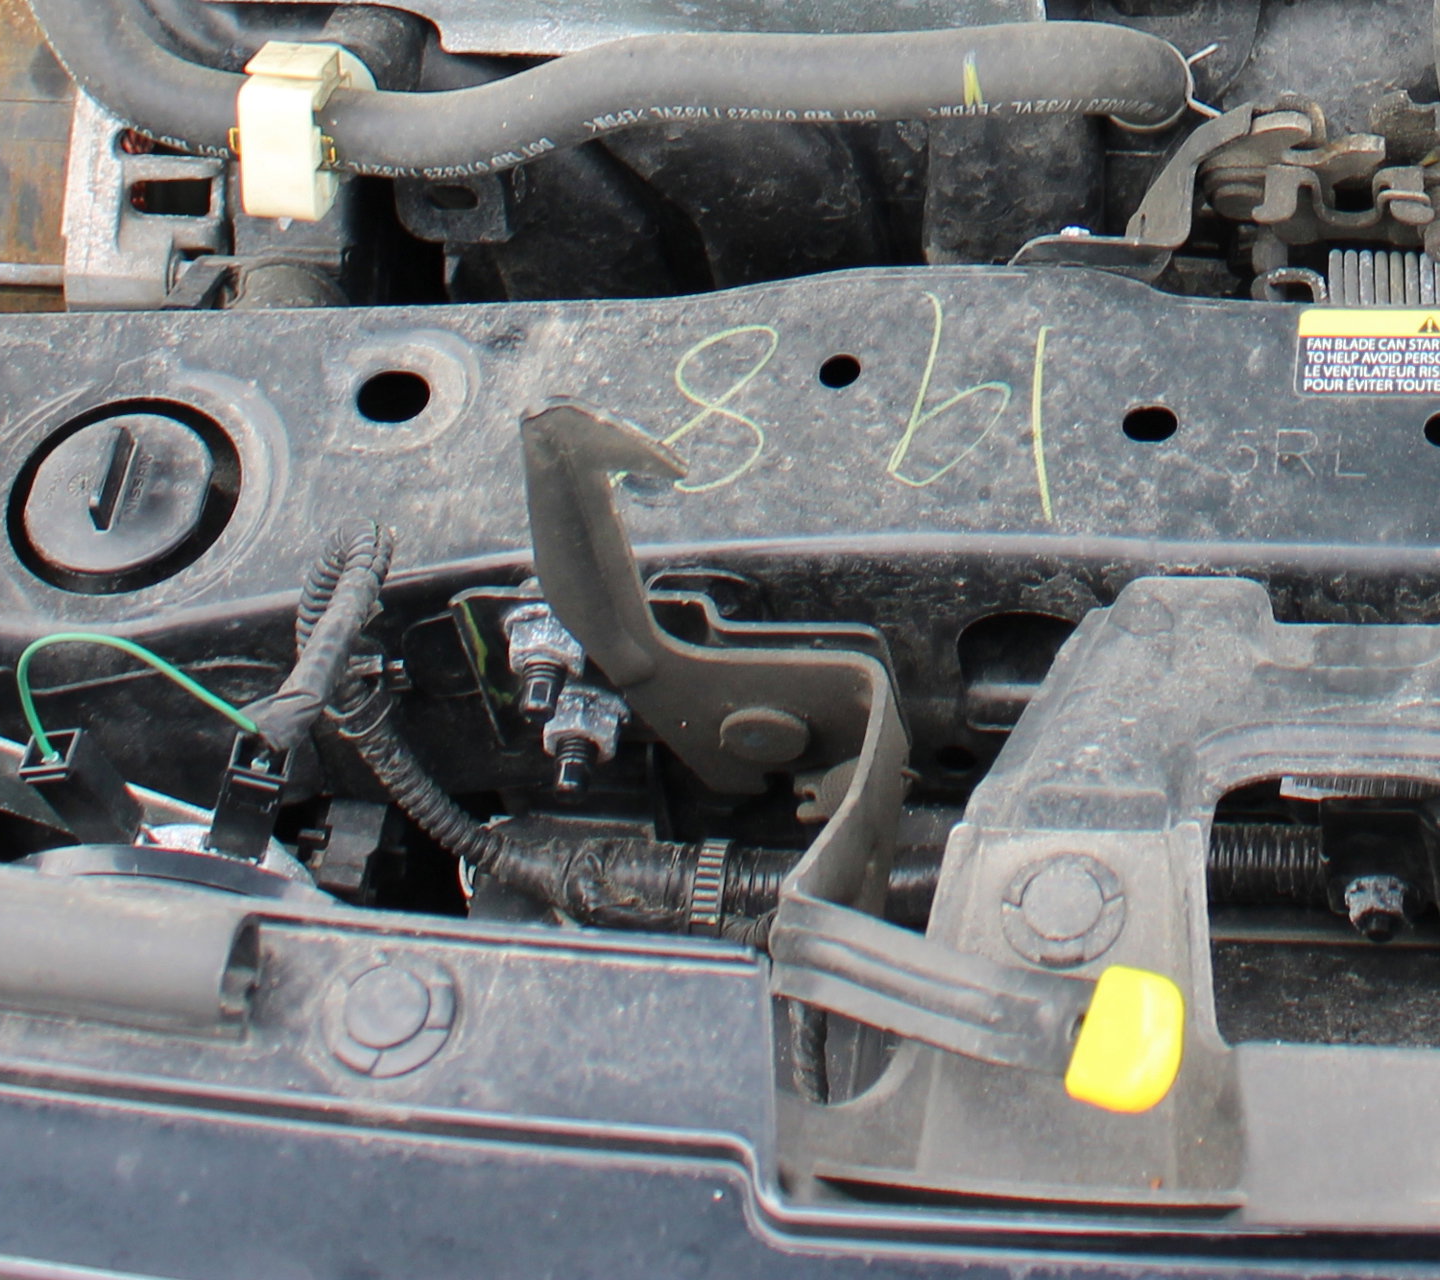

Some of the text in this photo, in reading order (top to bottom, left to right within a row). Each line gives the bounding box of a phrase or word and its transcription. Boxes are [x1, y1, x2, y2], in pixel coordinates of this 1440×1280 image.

[1307, 338, 1332, 350] FAN
[1334, 338, 1375, 351] BLADE
[1378, 338, 1406, 351] CAN
[1307, 352, 1325, 364] TO
[1327, 352, 1360, 364] HELP
[1361, 352, 1402, 365] AVOID
[1304, 365, 1321, 378] LE
[1323, 365, 1416, 378] VENTILATEUR
[1304, 379, 1343, 392] POUR
[1346, 377, 1393, 392] ÉVITER
[124, 453, 154, 514] NISSAN
